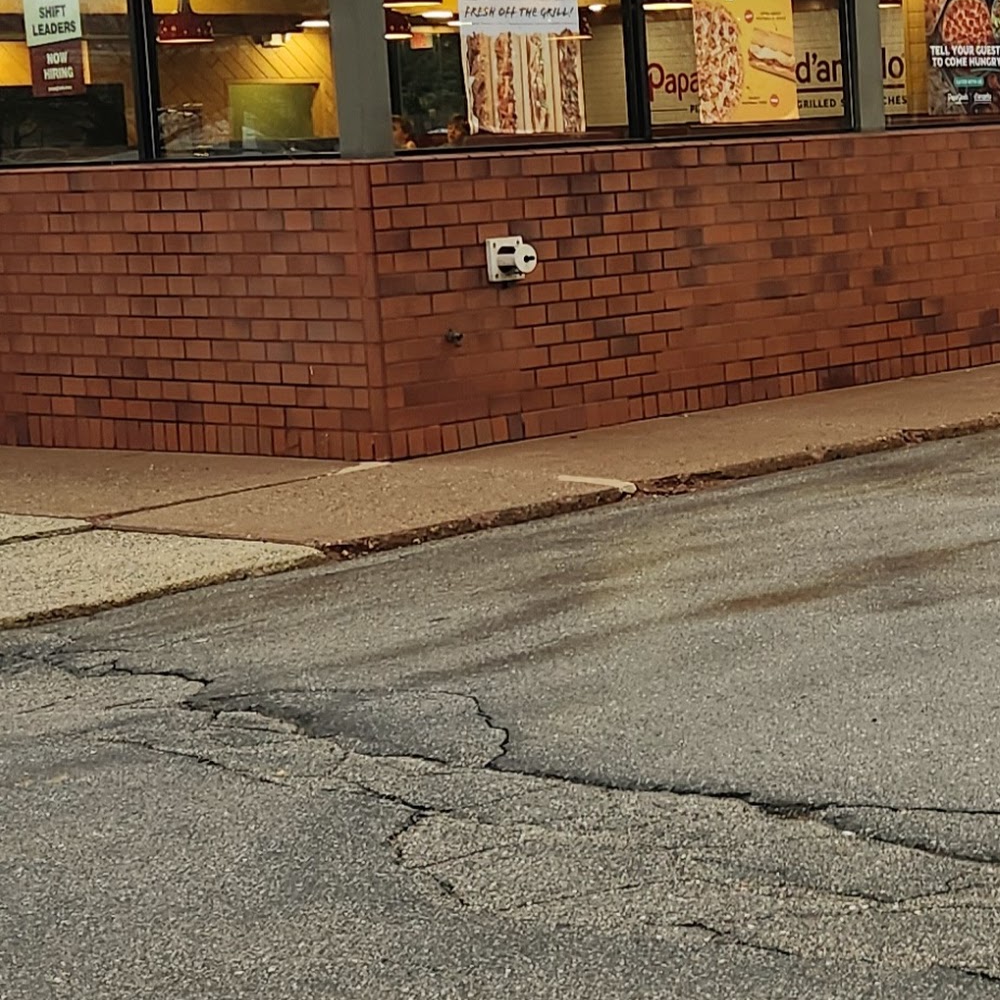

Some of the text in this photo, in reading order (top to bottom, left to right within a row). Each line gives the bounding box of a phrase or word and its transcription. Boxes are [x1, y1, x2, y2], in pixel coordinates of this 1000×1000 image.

[38, 5, 66, 19] SHIFT
[464, 5, 575, 18] FRESH OFF THE GRILL!
[32, 21, 77, 36] LEADERS
[929, 45, 951, 56] TELL
[951, 45, 974, 56] YOUR
[46, 51, 69, 65] NOW
[931, 57, 942, 67] TO
[944, 57, 968, 67] COME
[43, 66, 75, 81] HIRING
[648, 63, 699, 101] Papa
[797, 96, 837, 109] GRILLED
